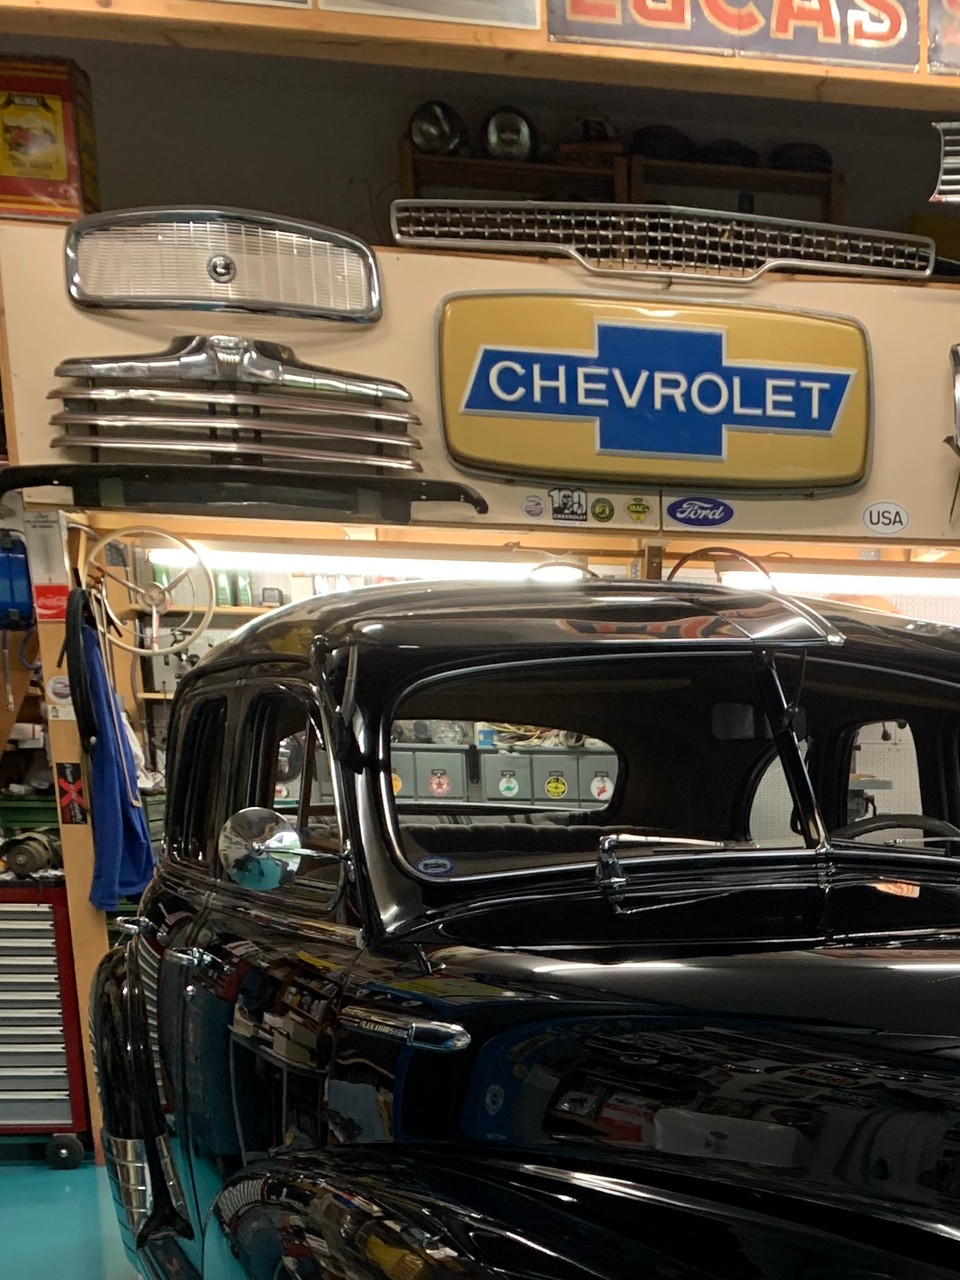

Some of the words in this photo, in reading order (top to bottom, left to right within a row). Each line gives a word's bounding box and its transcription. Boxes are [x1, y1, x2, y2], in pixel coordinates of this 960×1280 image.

[488, 359, 831, 420] CHEVROLET
[676, 500, 724, 521] Ford
[869, 510, 904, 526] USA
